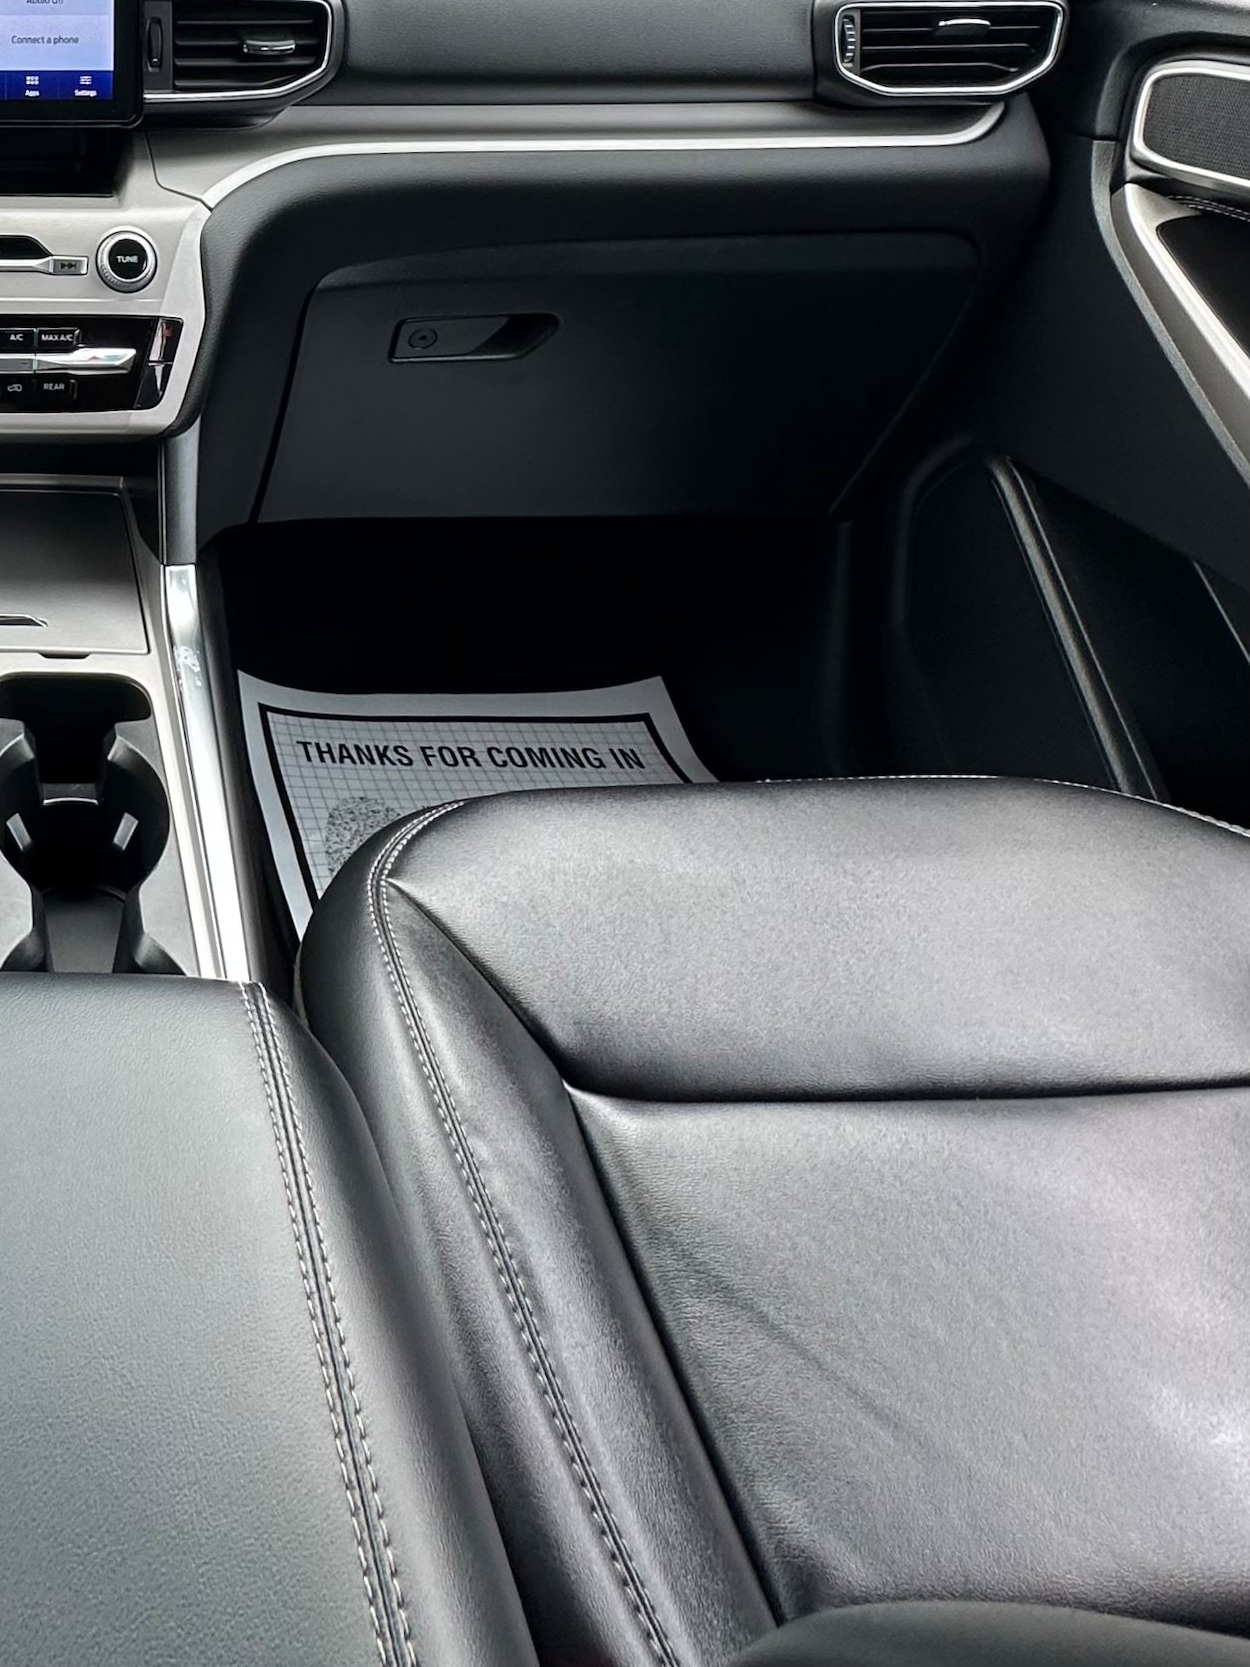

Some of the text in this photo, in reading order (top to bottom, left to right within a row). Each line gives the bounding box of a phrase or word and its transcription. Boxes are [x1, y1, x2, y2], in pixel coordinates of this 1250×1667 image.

[12, 36, 45, 44] Connect
[53, 36, 79, 46] phone
[116, 255, 139, 263] TUNE
[9, 333, 24, 341] A/C
[43, 383, 65, 391] REAR
[296, 740, 646, 770] THANKS FOR COMING IN
